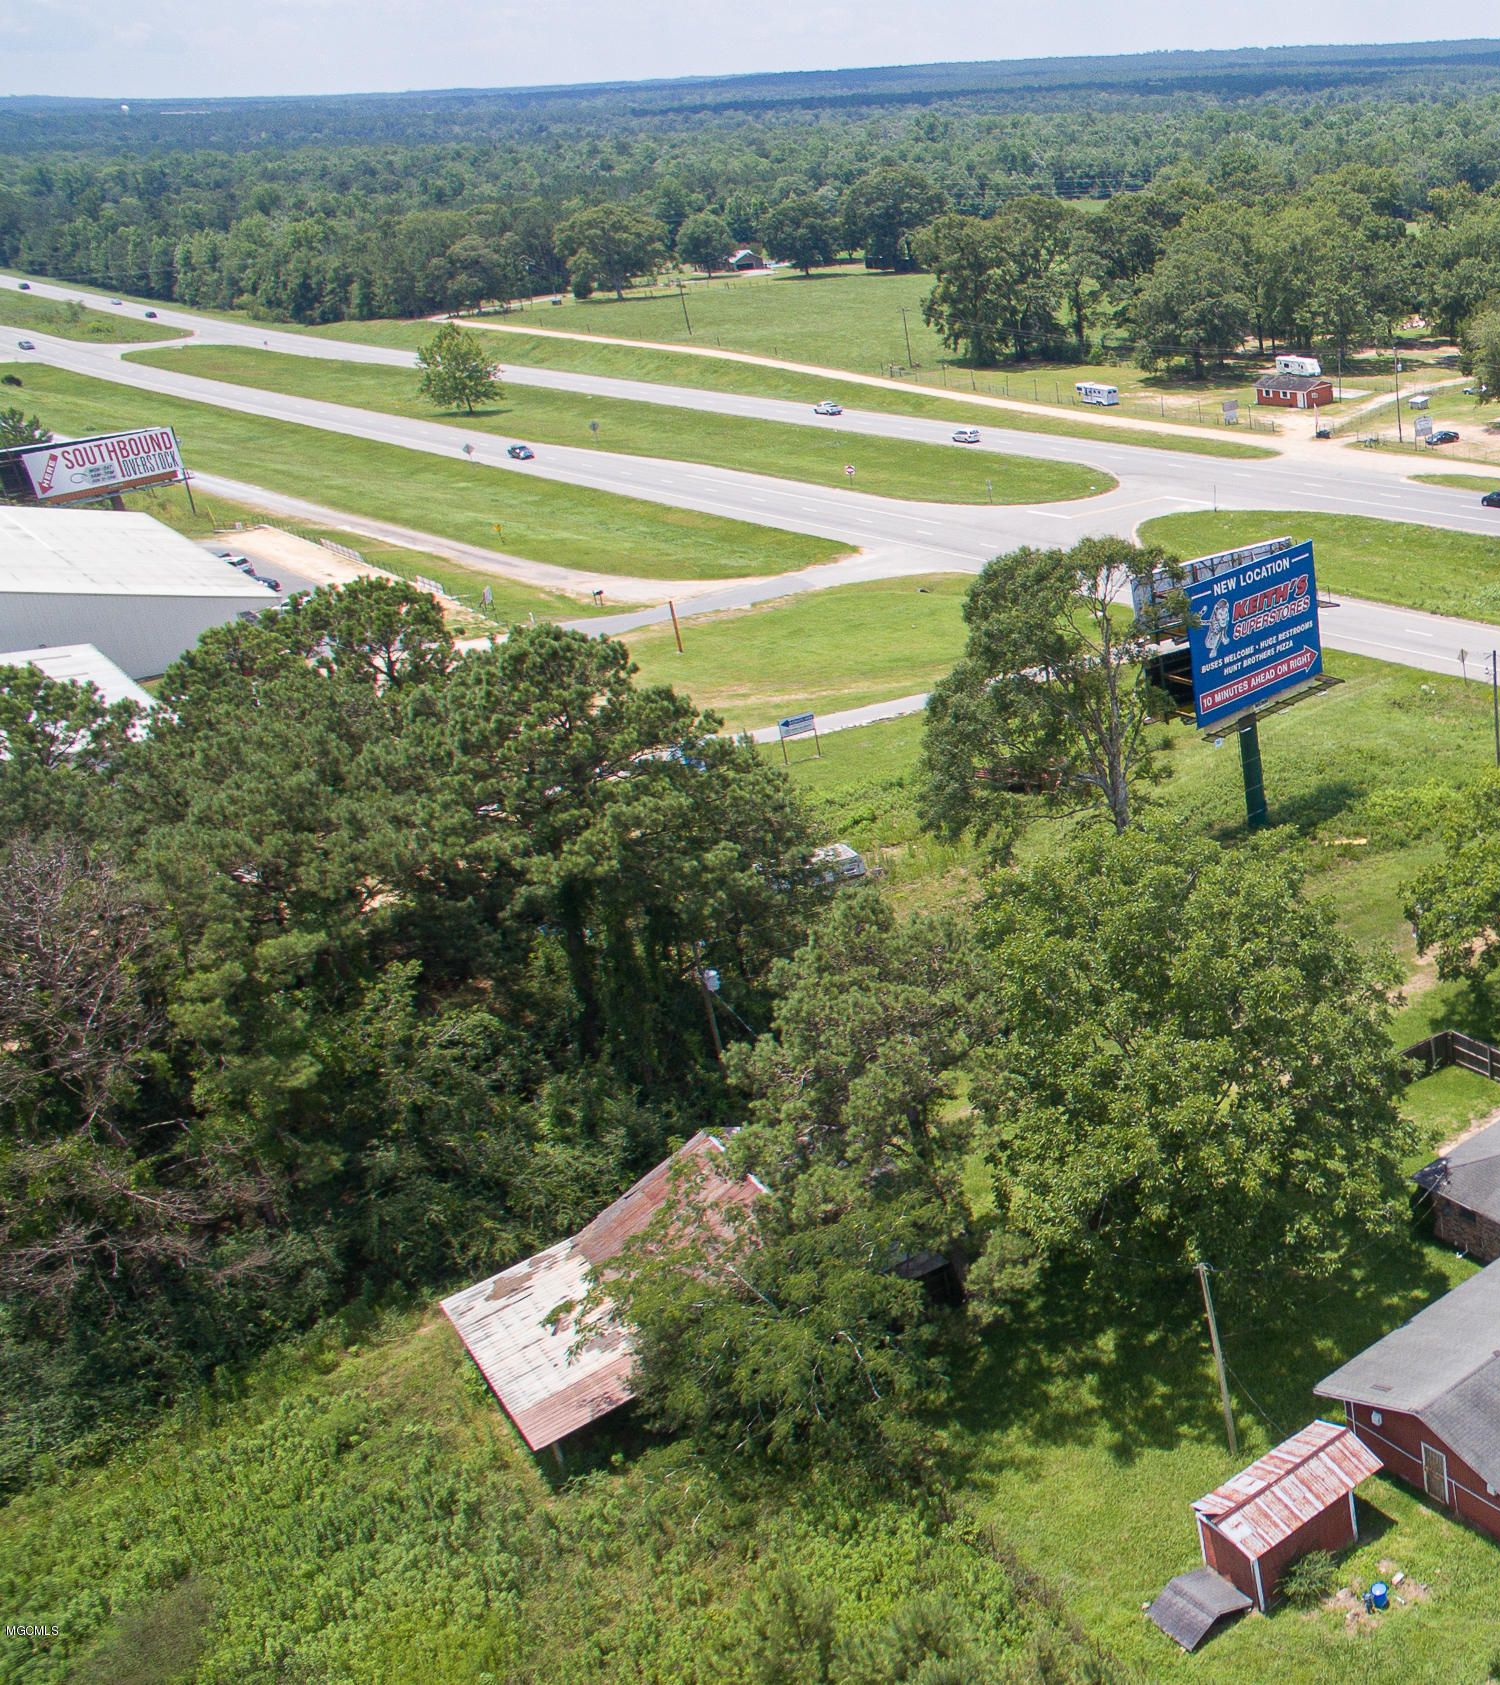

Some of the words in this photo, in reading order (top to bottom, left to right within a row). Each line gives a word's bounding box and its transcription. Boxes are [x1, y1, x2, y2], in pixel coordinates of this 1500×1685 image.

[41, 460, 56, 488] HERE
[61, 431, 173, 478] SOUTHBOUND
[122, 450, 179, 478] OVERSTOCK
[1213, 577, 1236, 597] NEW
[1240, 557, 1290, 587] LOCATION
[1232, 574, 1309, 624] KEITH'S
[1233, 595, 1311, 641] SUPERSTORES
[1201, 658, 1223, 674] BUSES
[1224, 645, 1255, 665] WELCOME
[1260, 635, 1277, 649] HUGE
[1278, 620, 1314, 642] RESTROOMS
[1223, 662, 1242, 676] HUNT
[1243, 648, 1275, 668] BROTHERS
[1276, 640, 1294, 654] PIZZA
[1203, 695, 1213, 708] 10
[1214, 682, 1249, 703] MINUTES
[1250, 668, 1276, 688] AHEAD
[1277, 663, 1288, 675] ON
[1289, 653, 1312, 670] RIGHT
